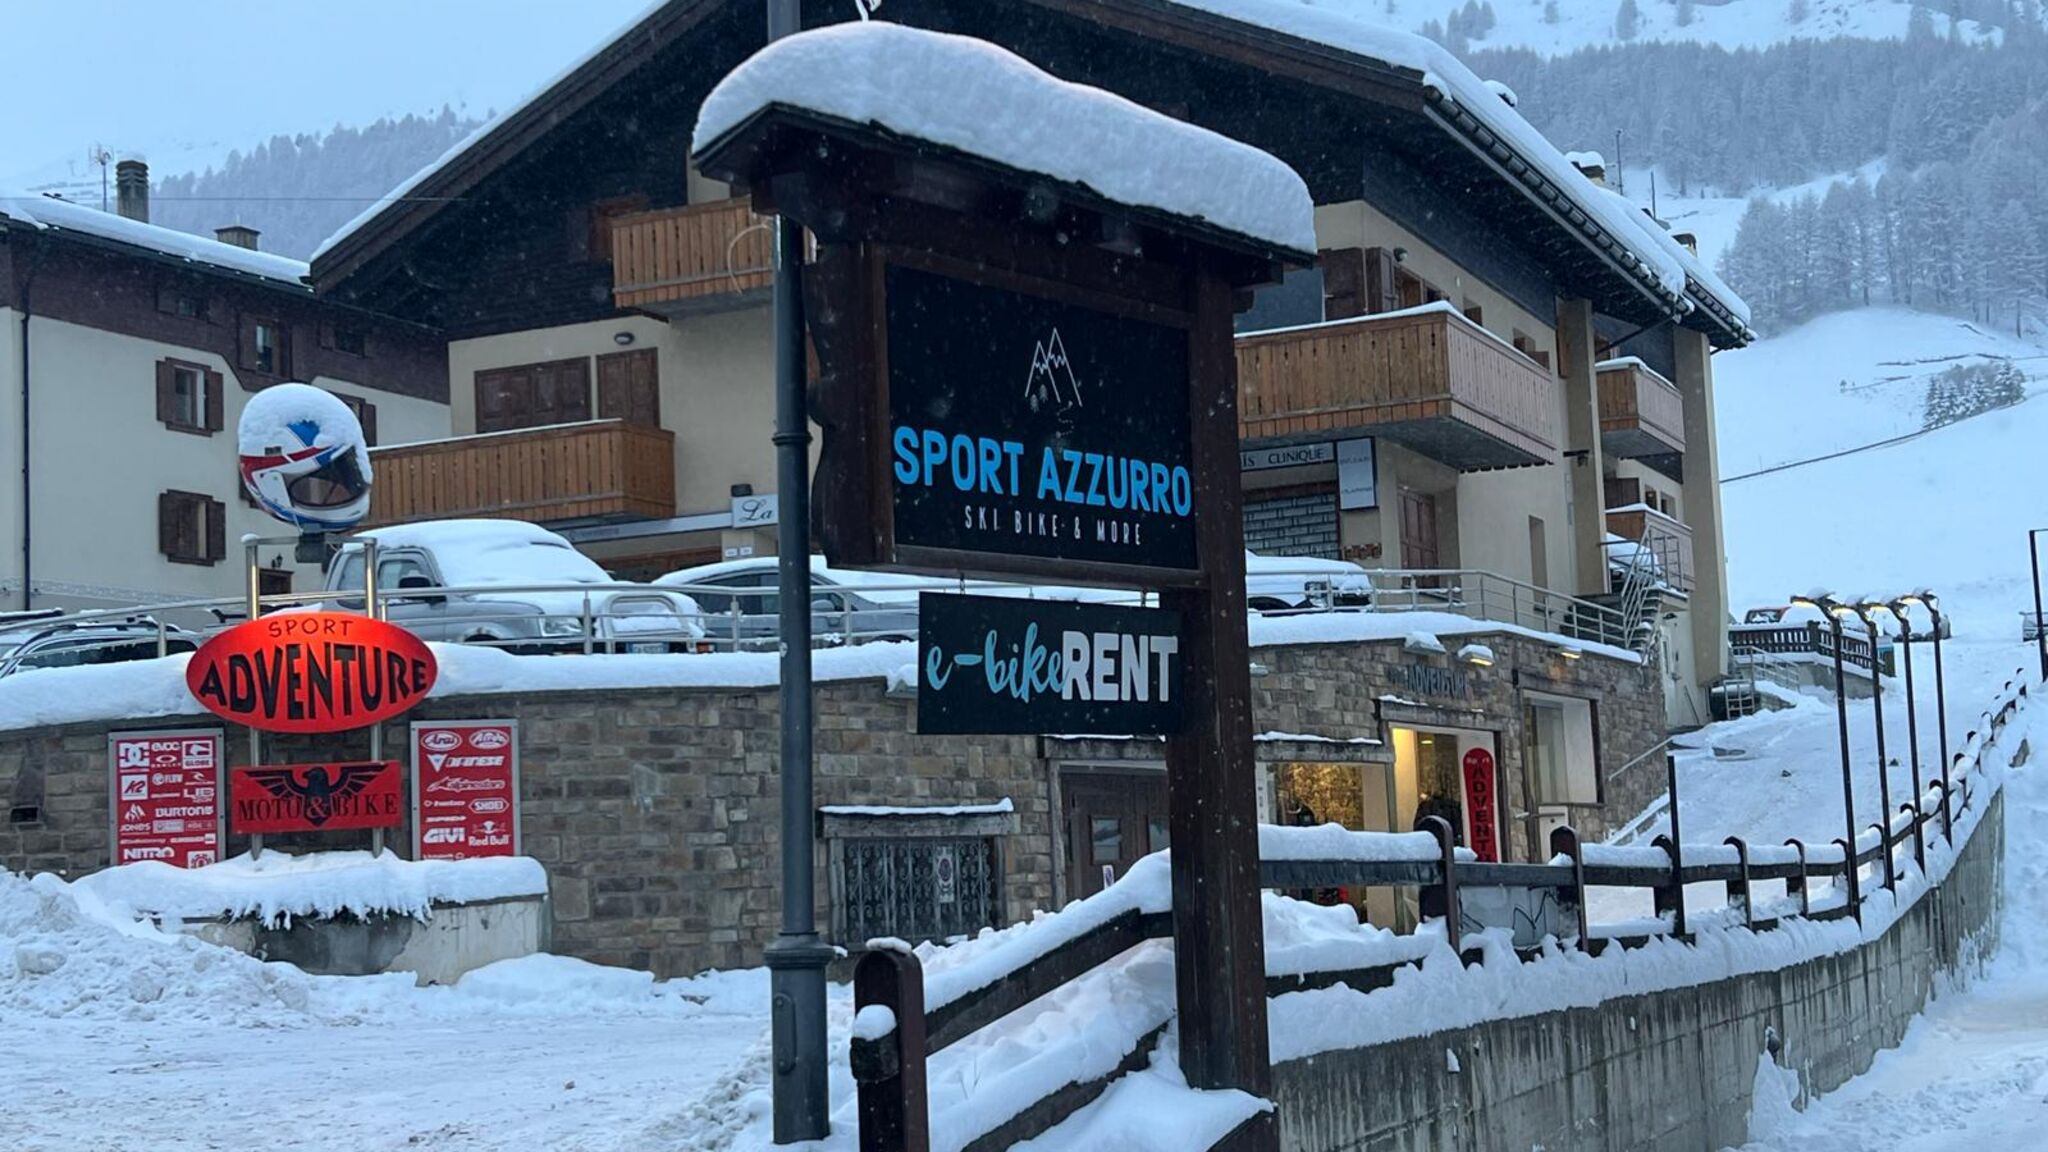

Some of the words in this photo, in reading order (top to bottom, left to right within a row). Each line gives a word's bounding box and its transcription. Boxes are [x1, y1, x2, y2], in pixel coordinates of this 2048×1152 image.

[893, 426, 1025, 497] SPORT
[1037, 446, 1192, 517] AZZURRO
[738, 499, 773, 522] La
[964, 504, 1000, 531] SKI
[1014, 509, 1059, 538] BIKE
[1073, 515, 1082, 540] &
[1096, 518, 1142, 546] MORE
[268, 617, 354, 638] SPORT
[1061, 630, 1179, 702] RENT
[198, 641, 427, 721] ADVENTURE
[238, 796, 301, 823] MOTO
[305, 796, 328, 820] &
[332, 792, 398, 818] BIKE
[422, 827, 466, 844] GIVI
[468, 835, 488, 847] Red
[123, 846, 175, 860] NITRO
